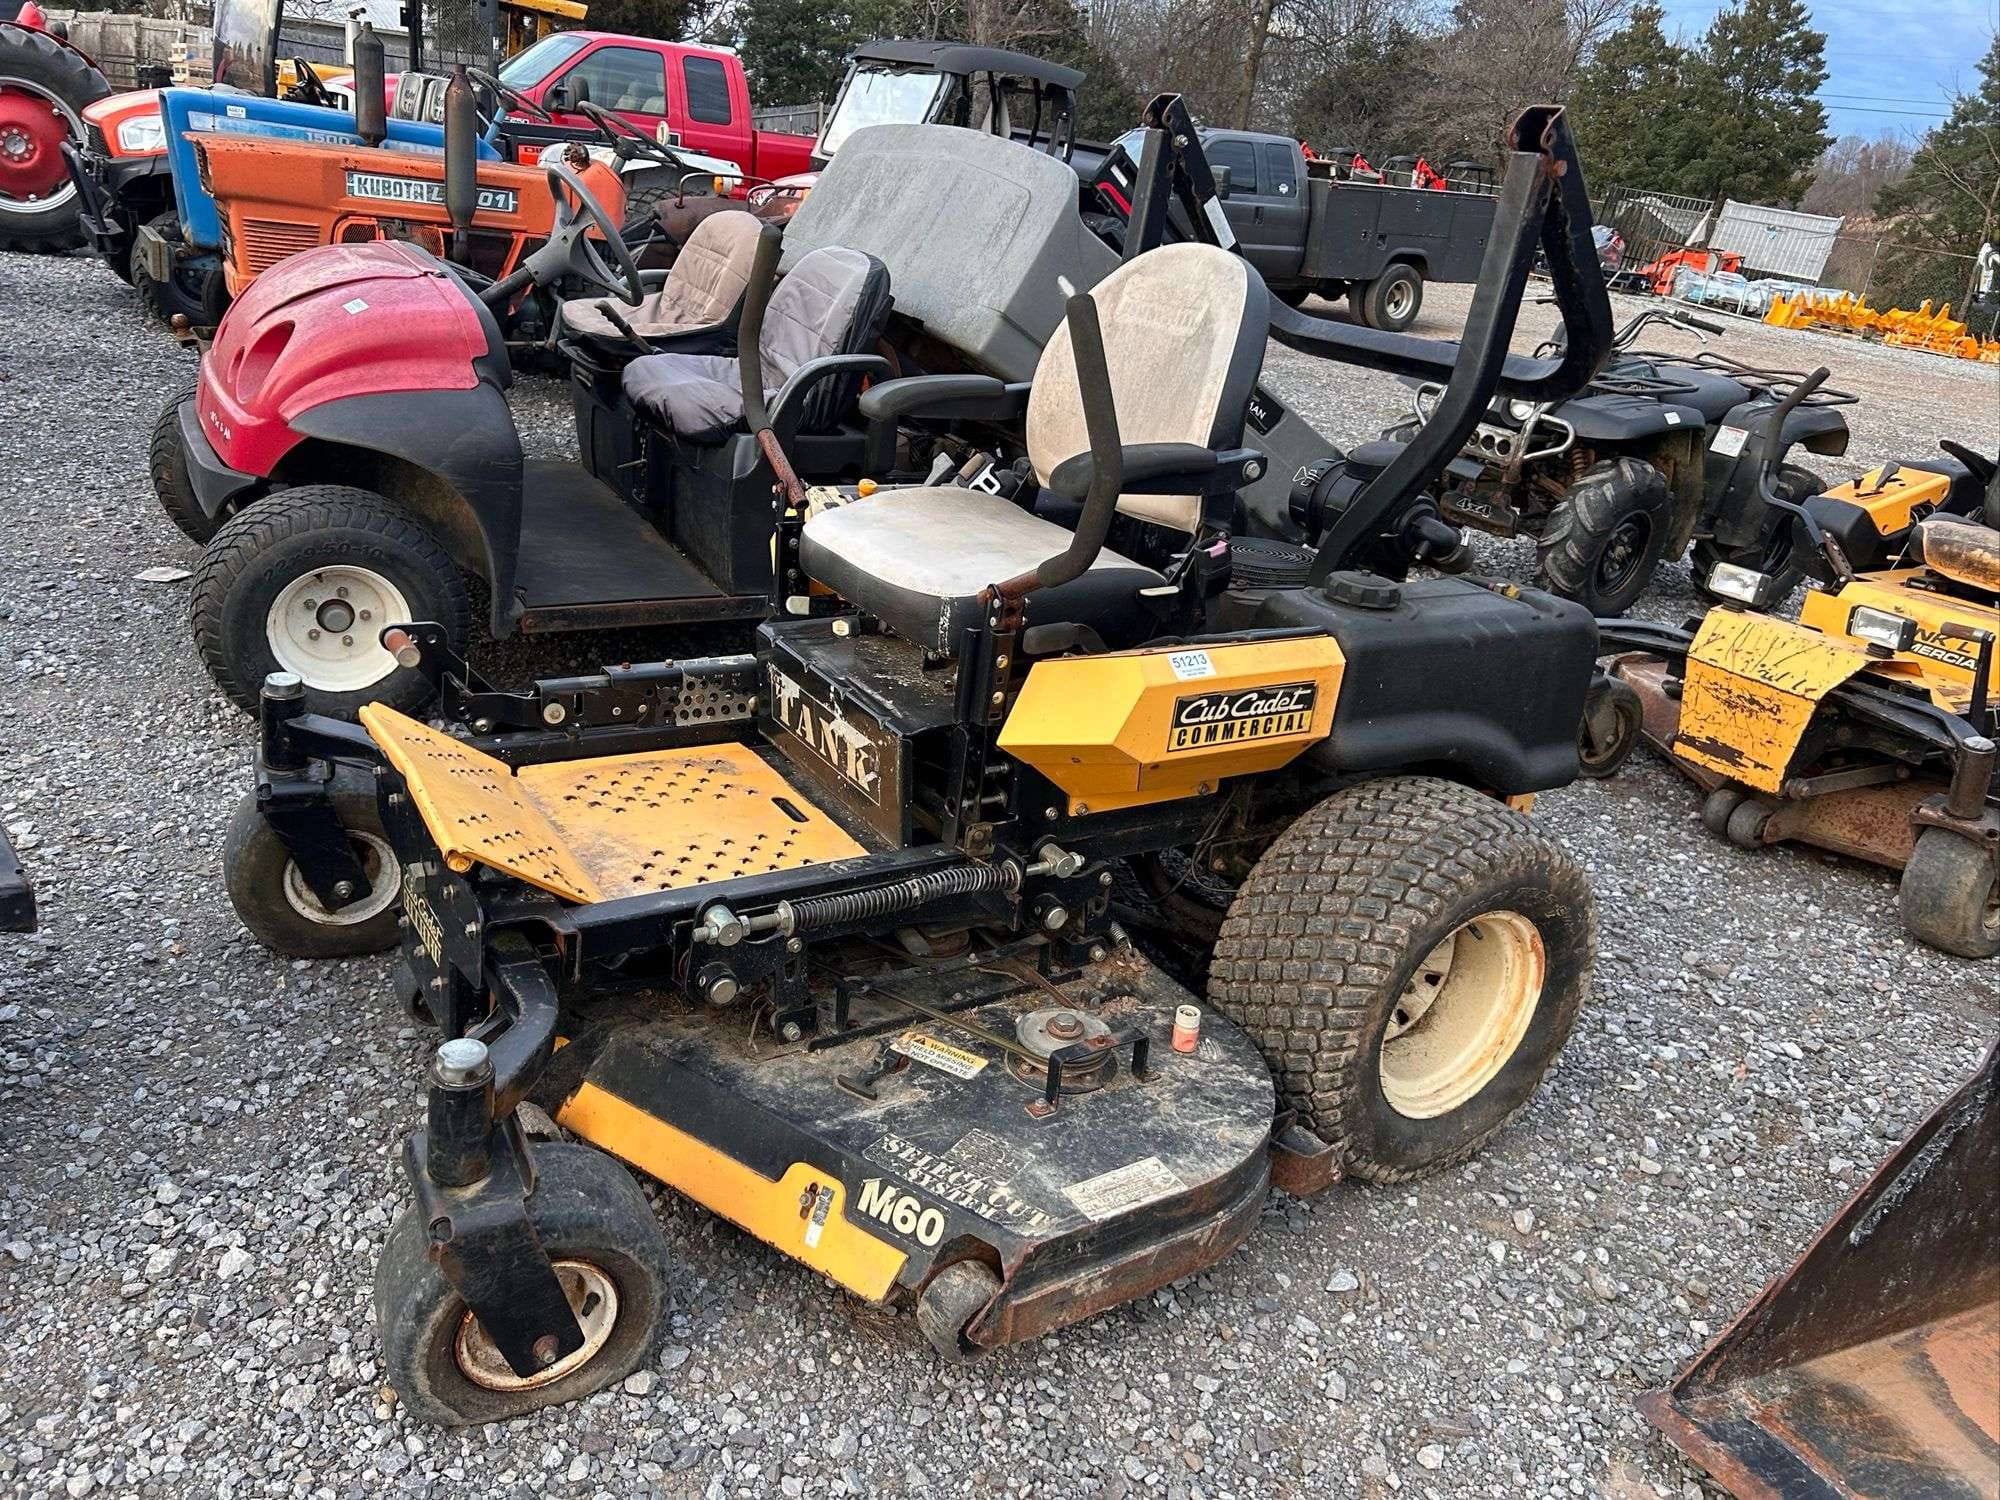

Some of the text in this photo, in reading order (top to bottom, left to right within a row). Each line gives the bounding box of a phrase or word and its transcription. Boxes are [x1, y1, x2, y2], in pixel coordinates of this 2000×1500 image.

[357, 175, 424, 201] KUBOTA
[1172, 653, 1208, 669] 51213
[1180, 687, 1312, 724] Cub Cadet
[774, 670, 878, 791] TANK
[1176, 713, 1305, 747] COMMERCIAL
[930, 1042, 976, 1065] WARNING
[856, 1177, 946, 1247] M60
